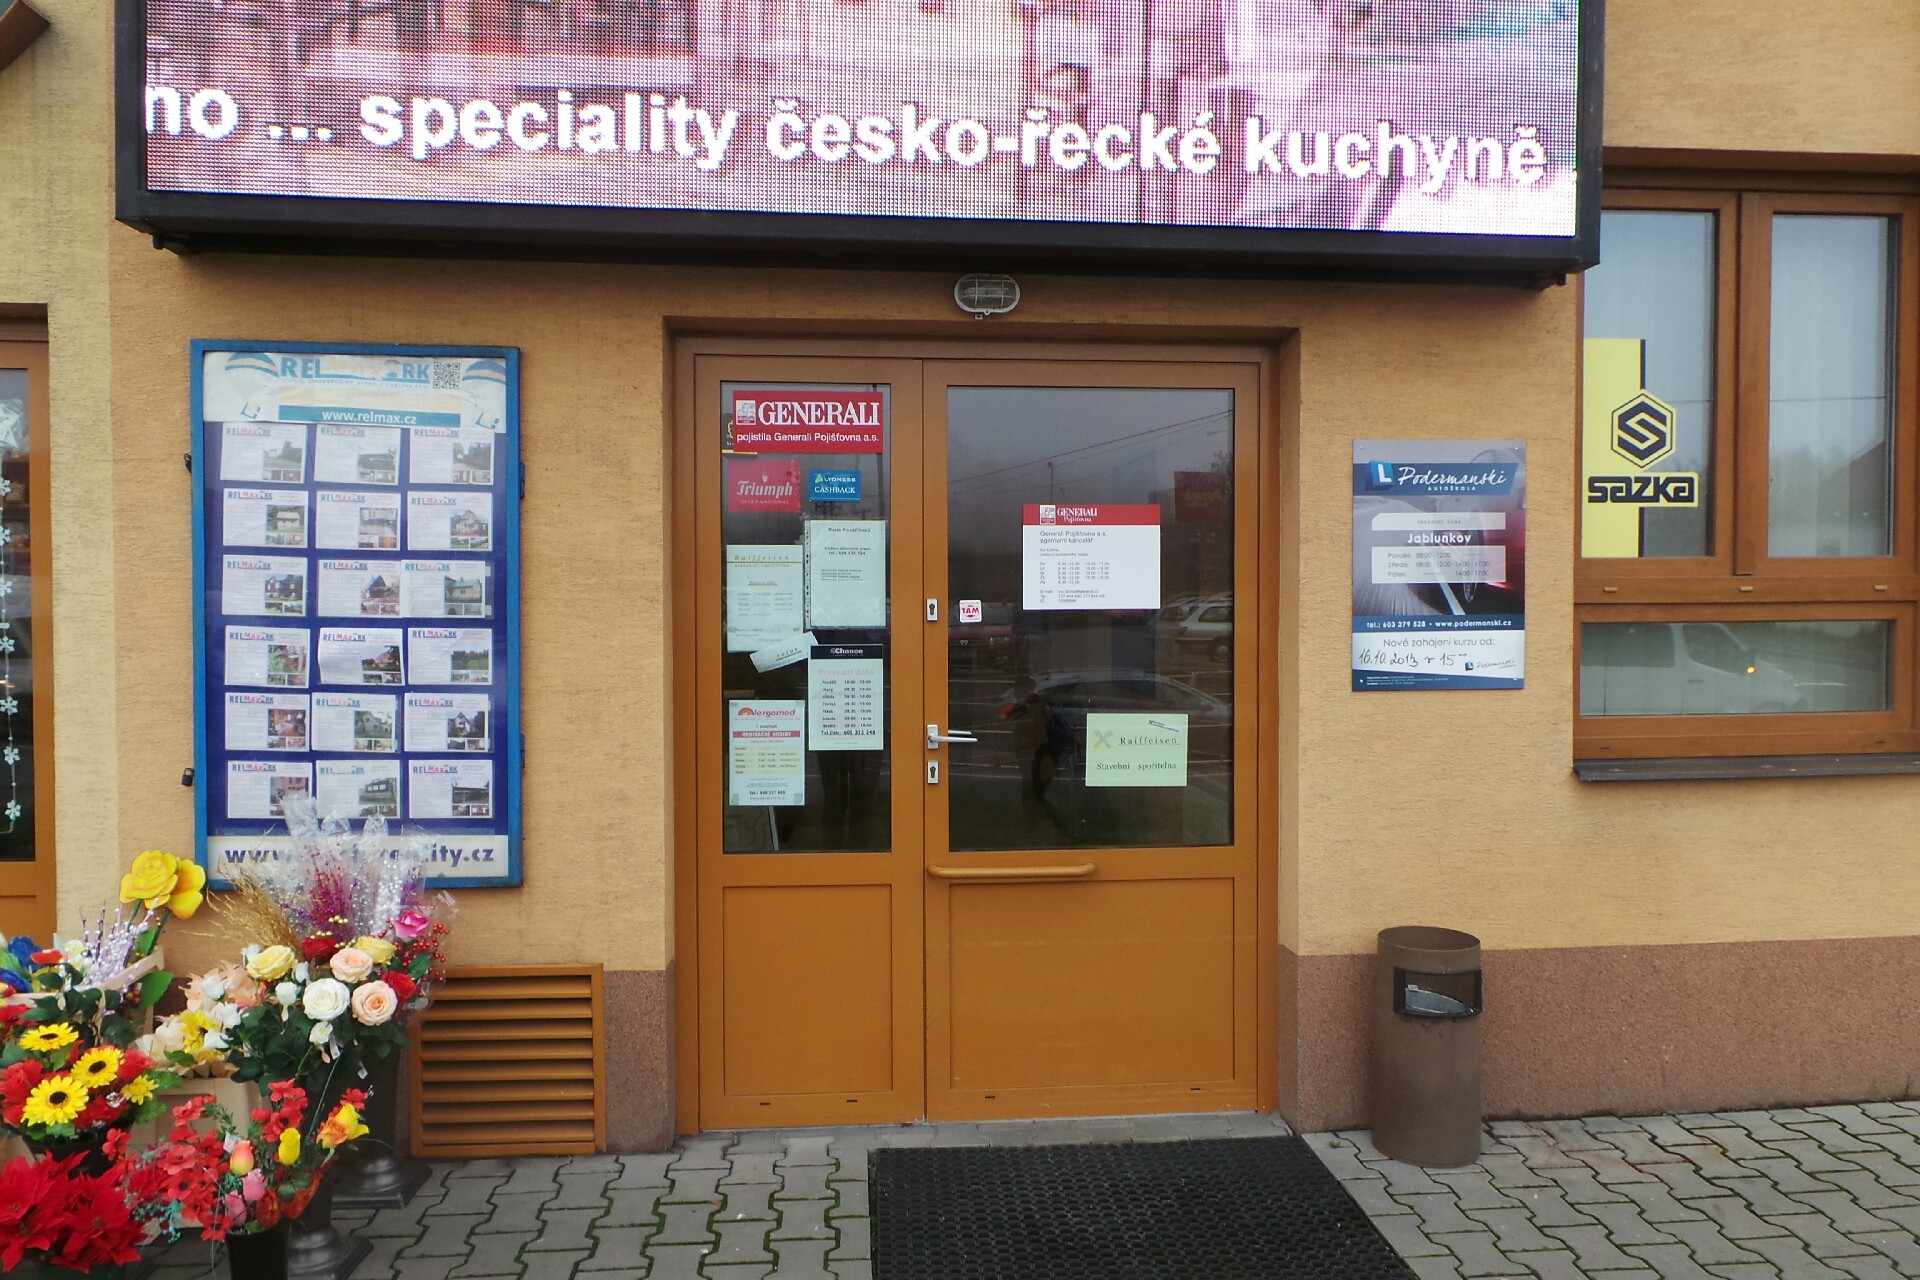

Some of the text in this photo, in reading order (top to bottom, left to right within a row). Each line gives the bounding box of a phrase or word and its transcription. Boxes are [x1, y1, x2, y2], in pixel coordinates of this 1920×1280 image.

[360, 90, 741, 171] speciality
[765, 101, 1222, 174] česko-řecké
[1245, 117, 1547, 198] kuchyně
[322, 410, 417, 425] www.relmax.cz
[758, 401, 880, 426] GENERALI
[737, 432, 771, 443] pojistila
[774, 432, 812, 441] Generali
[814, 432, 861, 443] Pojišťovna
[1398, 466, 1507, 486] Podermanski
[736, 481, 793, 498] Triumph
[814, 486, 856, 494] CASHBACK
[1057, 507, 1098, 516] GENERALI
[1407, 532, 1472, 544] Jablunkov
[1435, 619, 1512, 629] www.podermanski.cz
[1383, 637, 1495, 648] Nové zahájení kurzu od:
[1120, 737, 1177, 745] Raiffeisen
[1097, 762, 1177, 771] Stavební spořitelna
